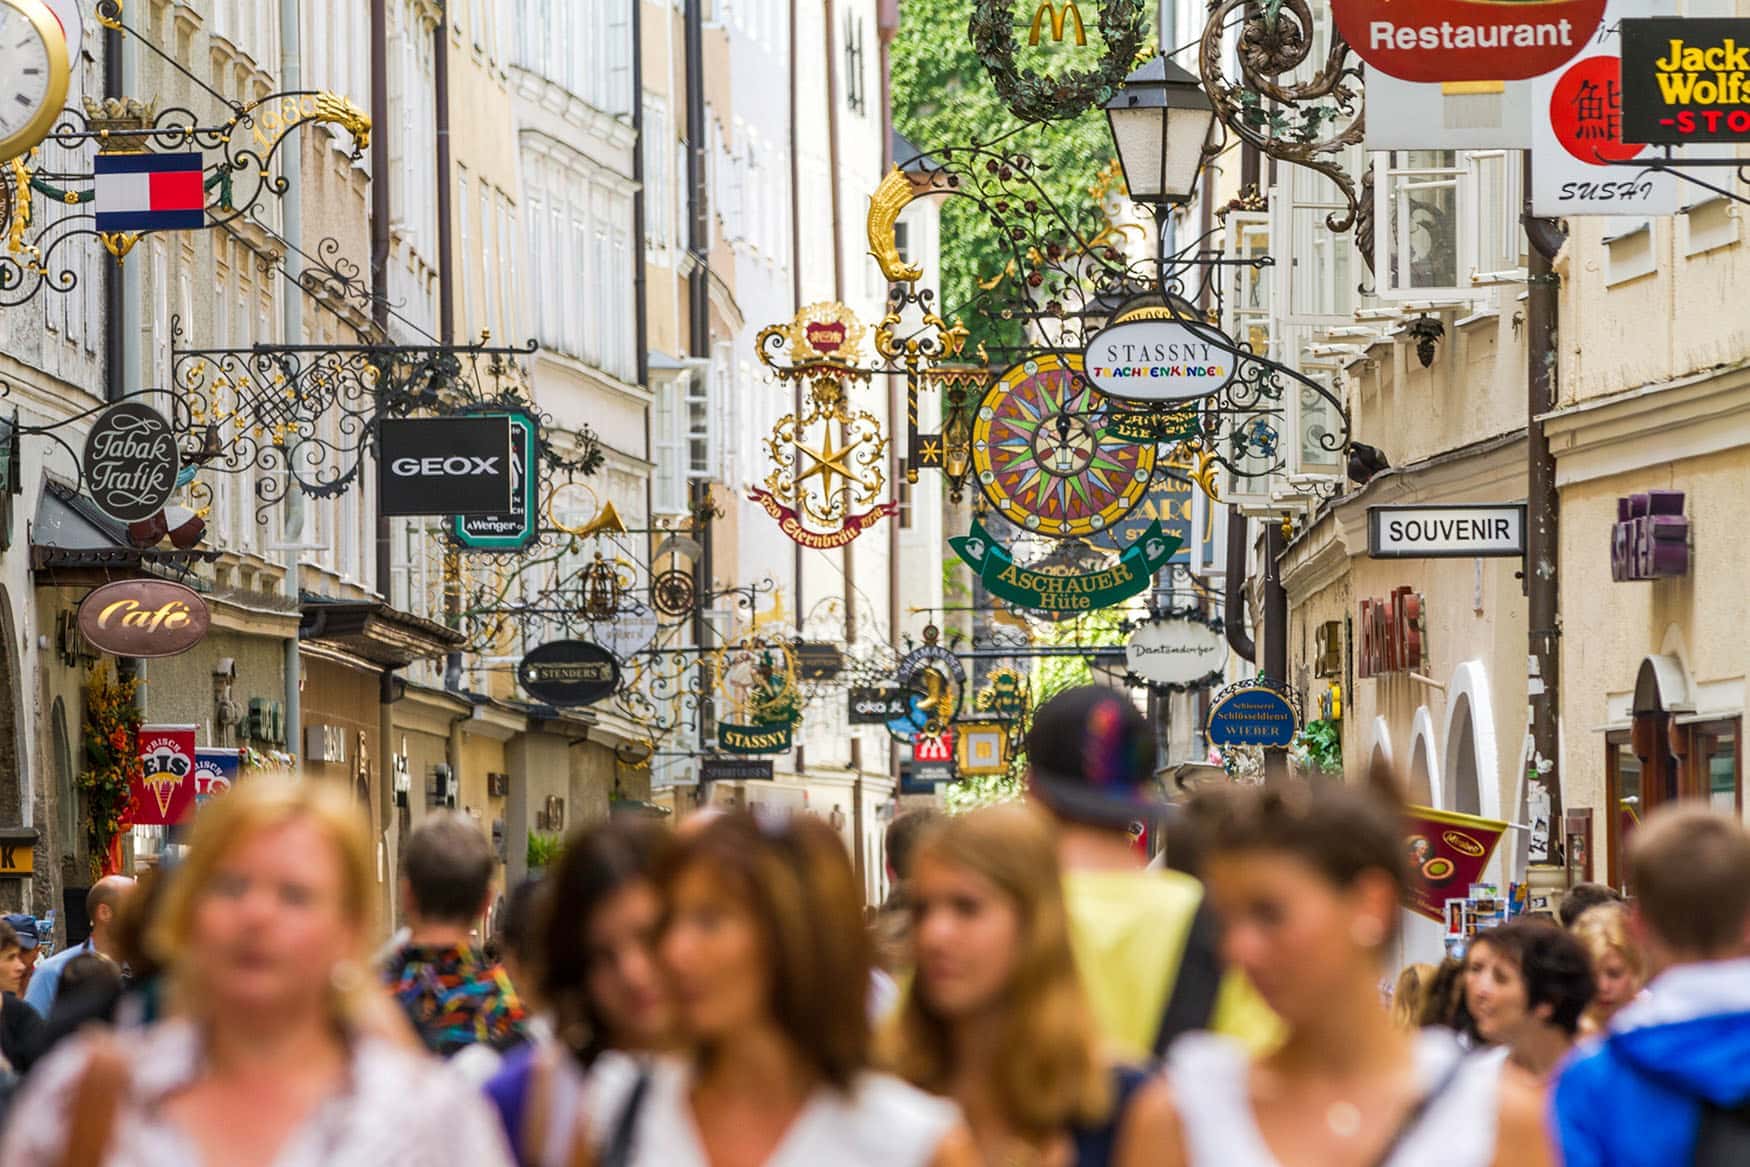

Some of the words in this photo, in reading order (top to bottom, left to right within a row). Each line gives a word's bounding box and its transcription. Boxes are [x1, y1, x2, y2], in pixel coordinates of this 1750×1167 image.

[1369, 18, 1573, 50] Restaurant
[1656, 38, 1750, 71] Jack
[1558, 181, 1654, 200] SUSHI
[1106, 343, 1212, 363] STASSNY
[92, 424, 173, 461] Tabak
[391, 456, 499, 476] GEOX
[91, 461, 170, 499] Trafik
[782, 516, 858, 548] Sternbräu
[1389, 518, 1511, 542] SOUVENIR
[997, 562, 1134, 594] ASCHAUER
[1039, 592, 1091, 609] Hüte
[541, 668, 598, 680] STENDERS
[146, 738, 181, 753] FRISCH
[724, 730, 787, 749] STASSNY
[143, 755, 189, 779] EIS
